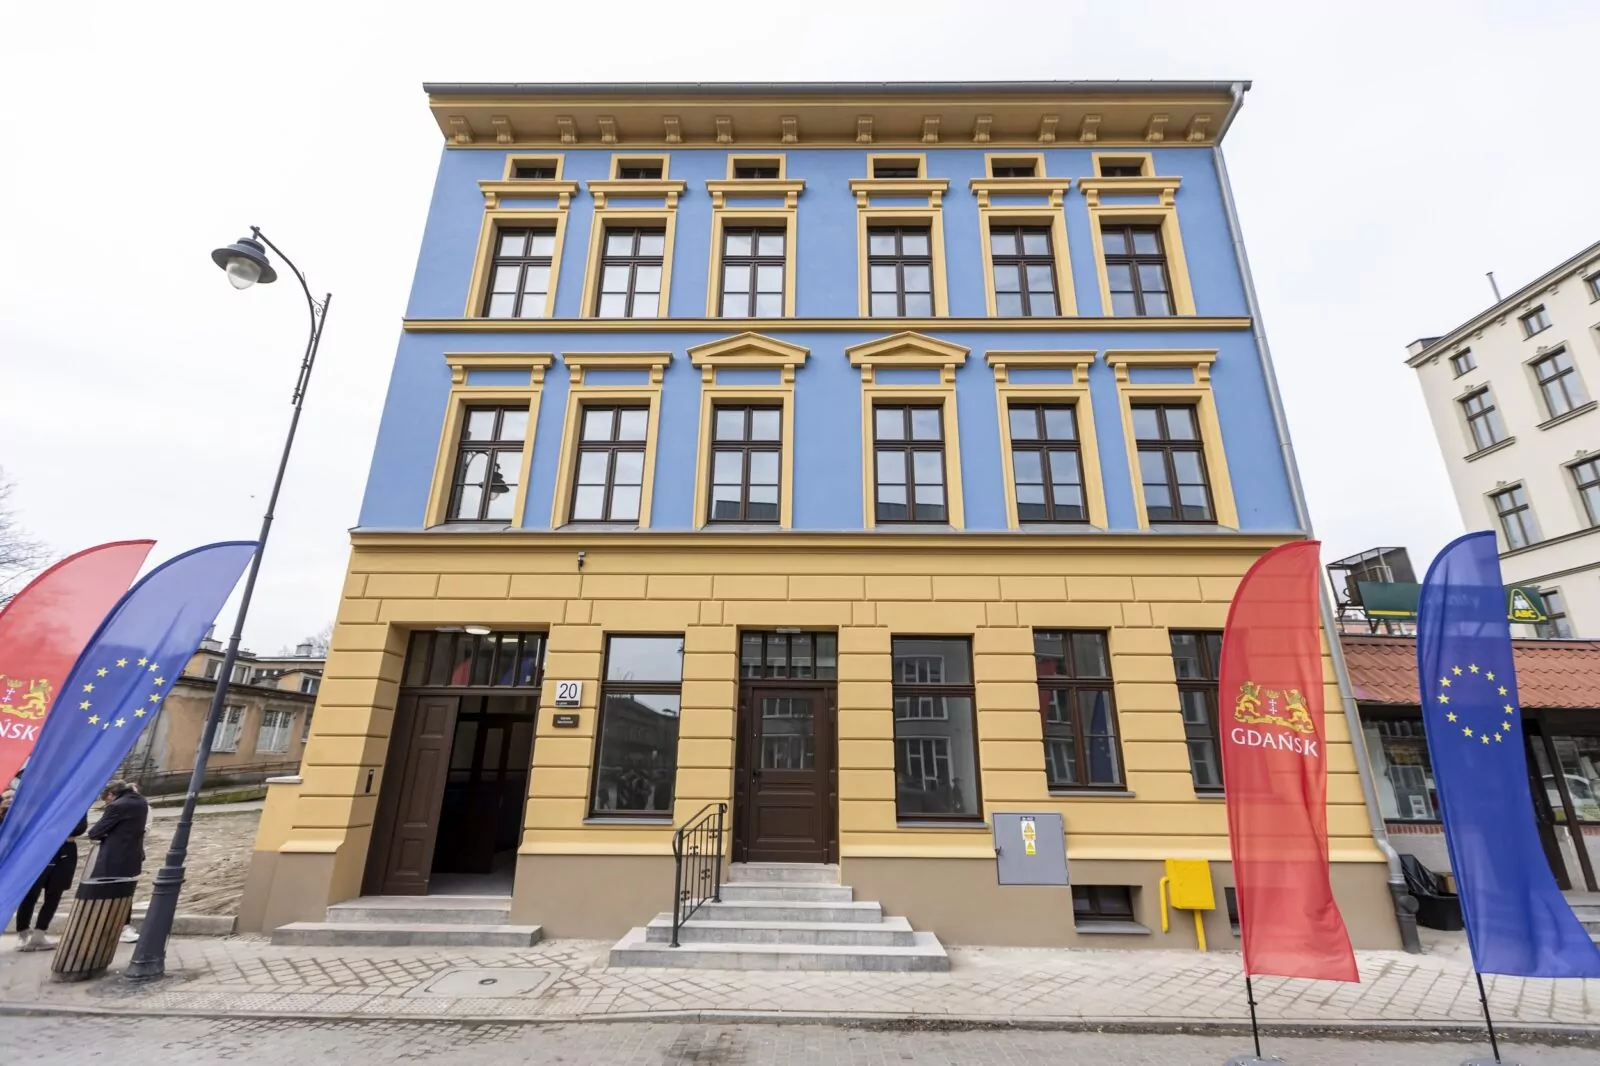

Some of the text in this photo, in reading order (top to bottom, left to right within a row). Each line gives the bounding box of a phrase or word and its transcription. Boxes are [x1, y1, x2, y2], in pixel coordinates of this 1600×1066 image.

[1515, 609, 1537, 618] ABC
[559, 683, 577, 699] 20
[1231, 728, 1318, 757] GDAŃSK
